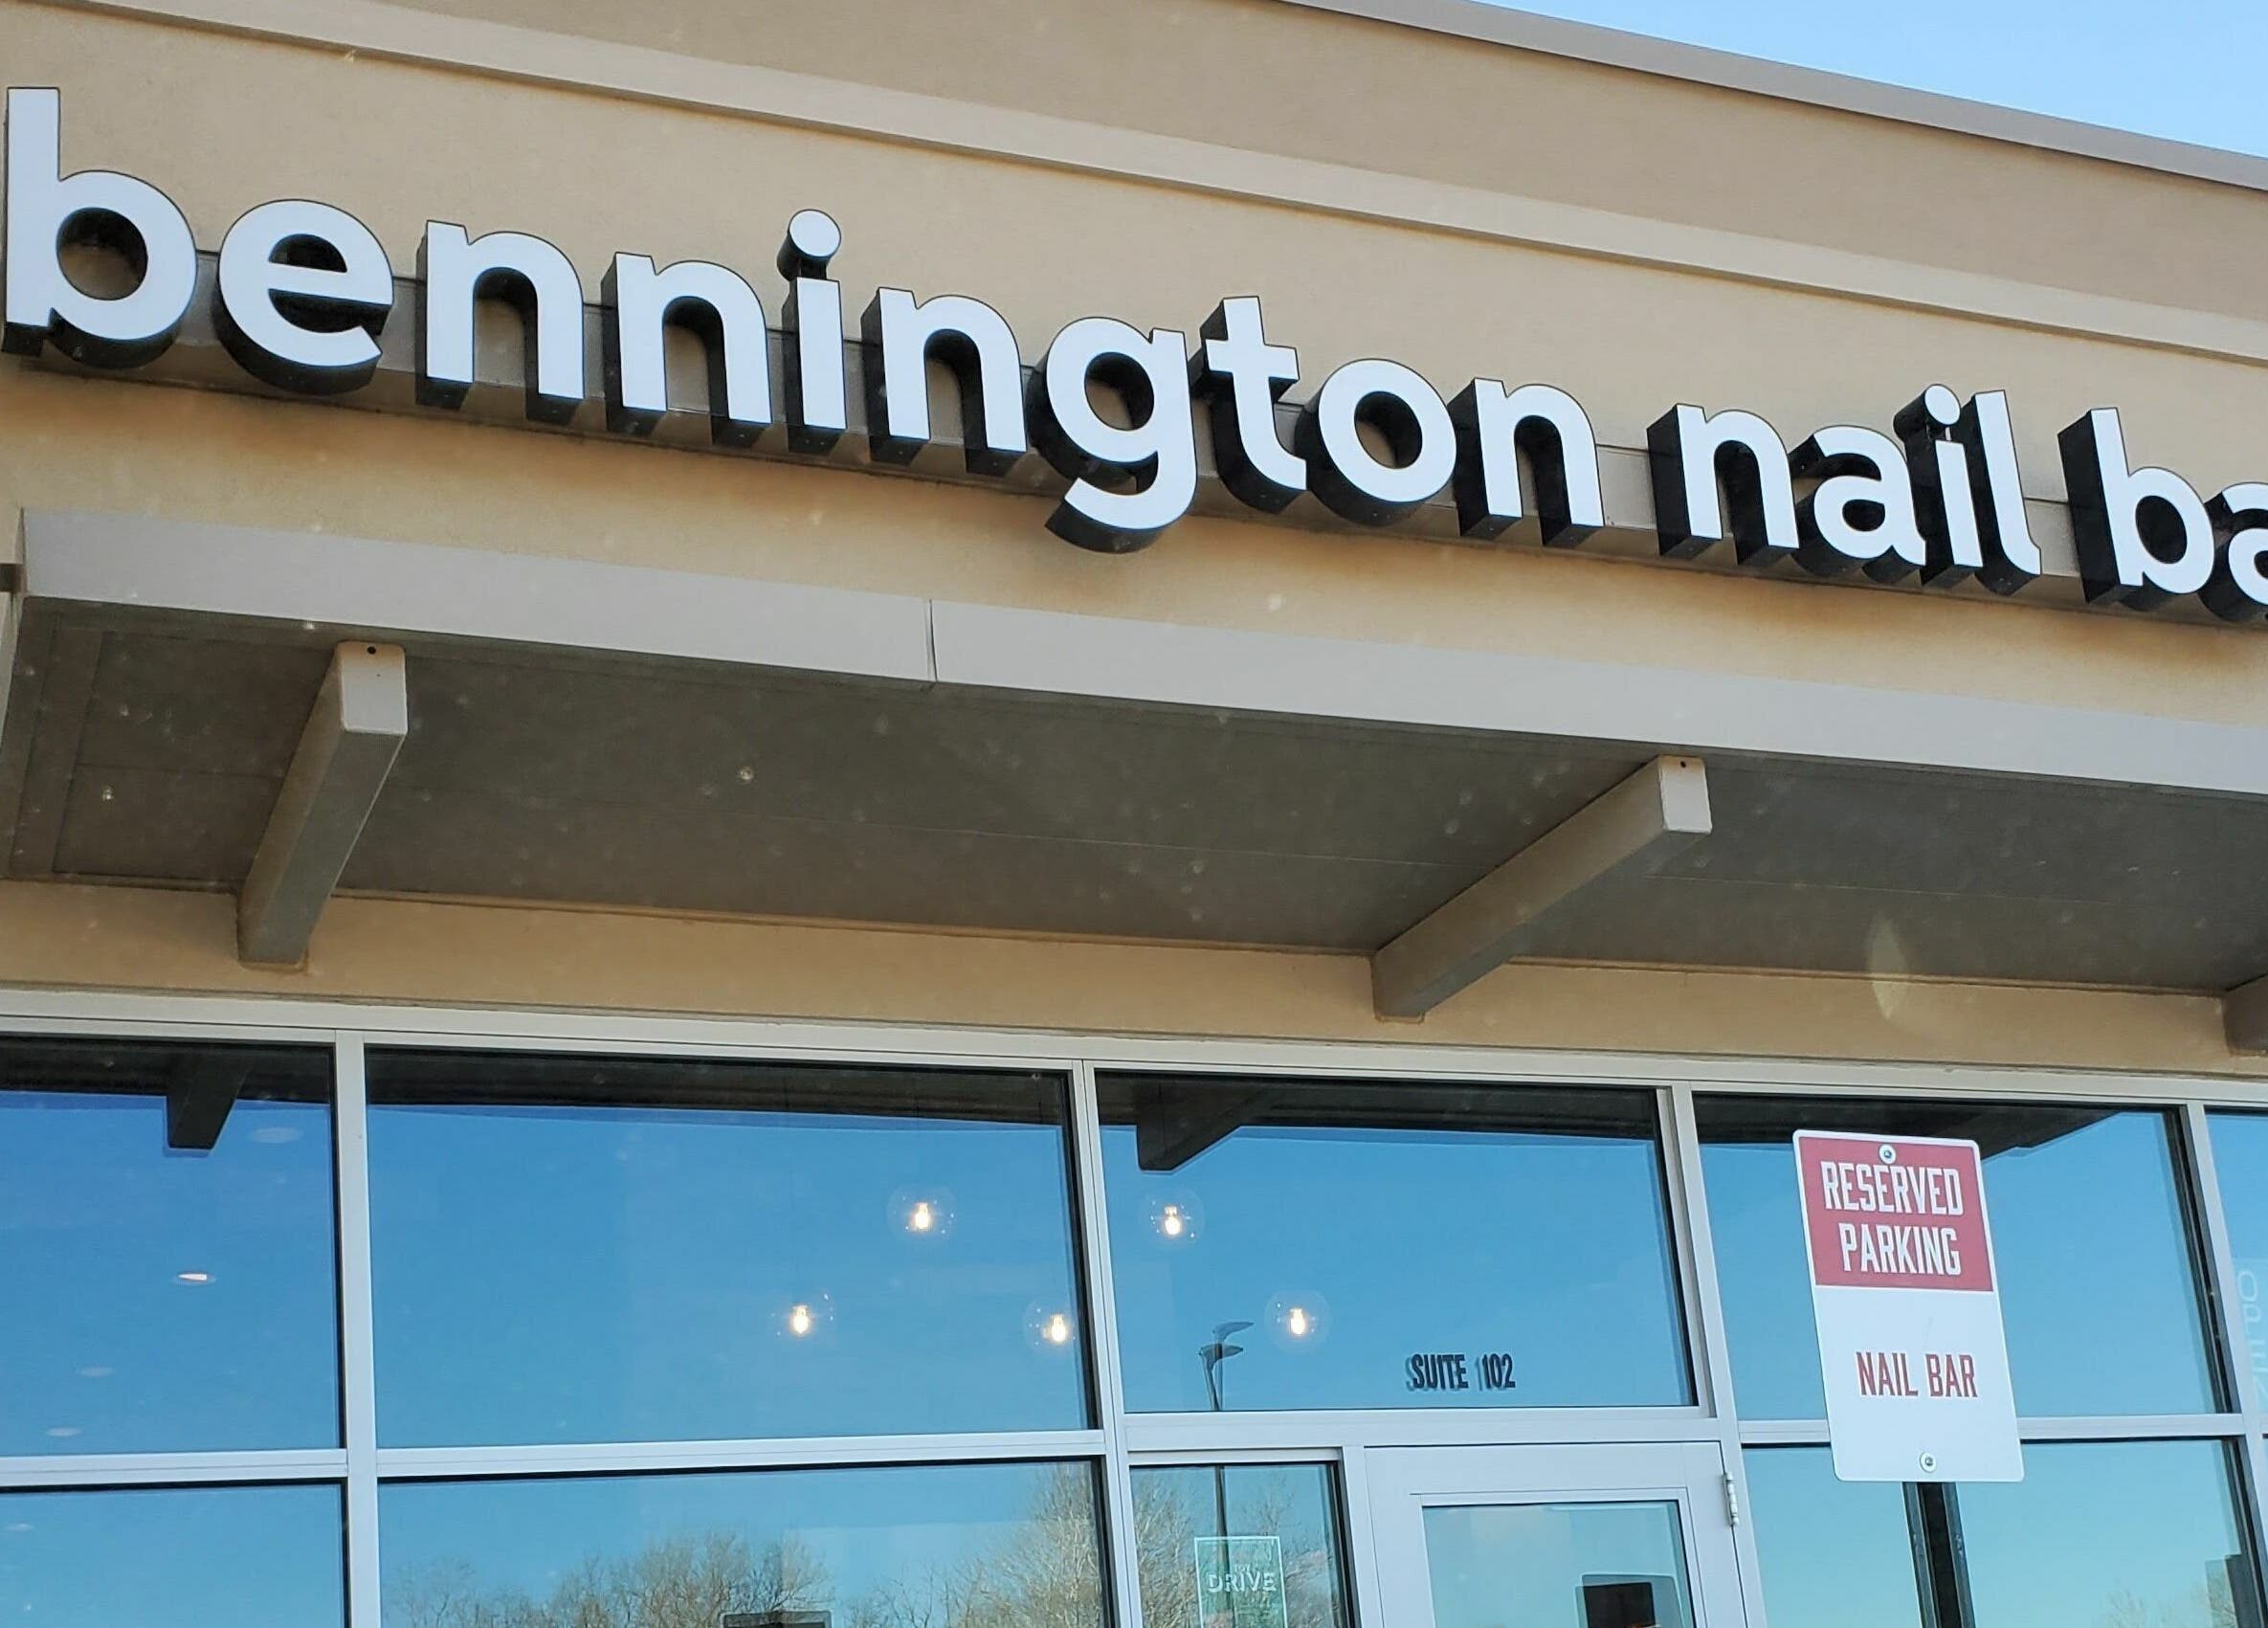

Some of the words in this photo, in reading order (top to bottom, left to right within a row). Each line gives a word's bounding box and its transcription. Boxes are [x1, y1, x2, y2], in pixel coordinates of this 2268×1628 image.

[6, 88, 1604, 534] bennington
[1674, 385, 2041, 576] nail
[1820, 1160, 1964, 1216] RESERVED
[1838, 1222, 1962, 1276] PARKING
[1411, 1353, 1469, 1390] SUITE
[1481, 1353, 1516, 1390] 102
[1856, 1350, 1919, 1396] NAIL
[1924, 1353, 1978, 1397] BAR
[1208, 1572, 1278, 1593] DRIVE
